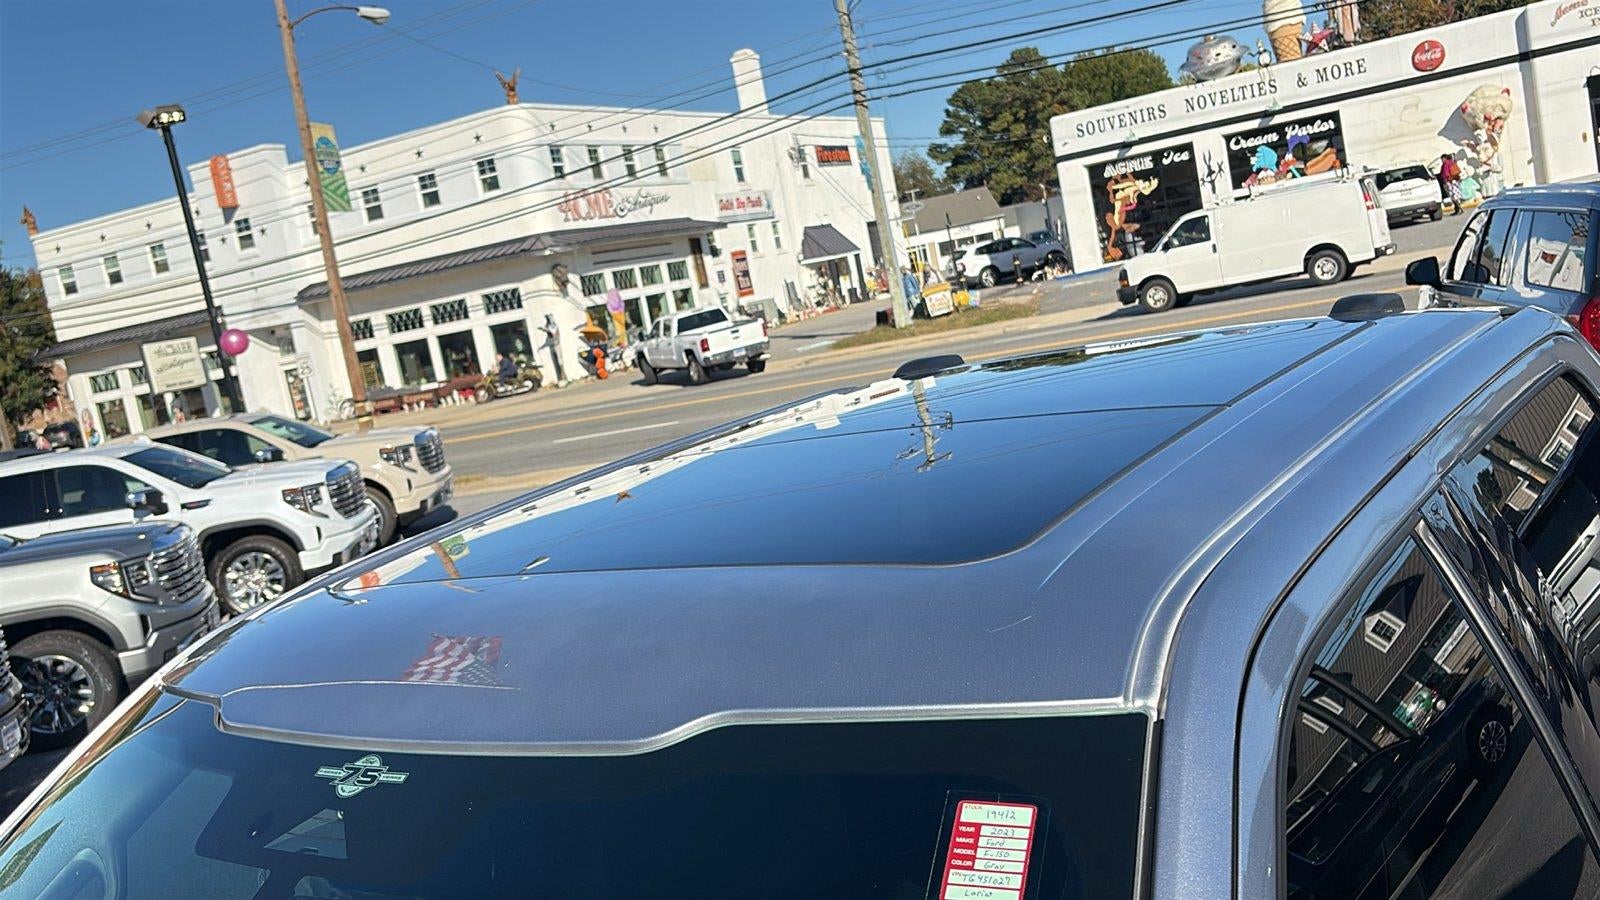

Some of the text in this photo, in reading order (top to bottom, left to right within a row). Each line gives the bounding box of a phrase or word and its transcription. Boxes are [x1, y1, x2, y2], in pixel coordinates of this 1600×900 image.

[1076, 58, 1367, 138] SOUVENIRS NOVELTIES & MORE
[1229, 119, 1335, 150] Cream Parlor
[1103, 150, 1191, 178] ACME Ice
[557, 187, 617, 222] ACME
[336, 765, 387, 785] 75
[986, 839, 1005, 847] Ford
[953, 847, 976, 855] MODEL
[983, 850, 1010, 858] F-150
[951, 859, 973, 867] COLOR
[983, 861, 1005, 870] Gray
